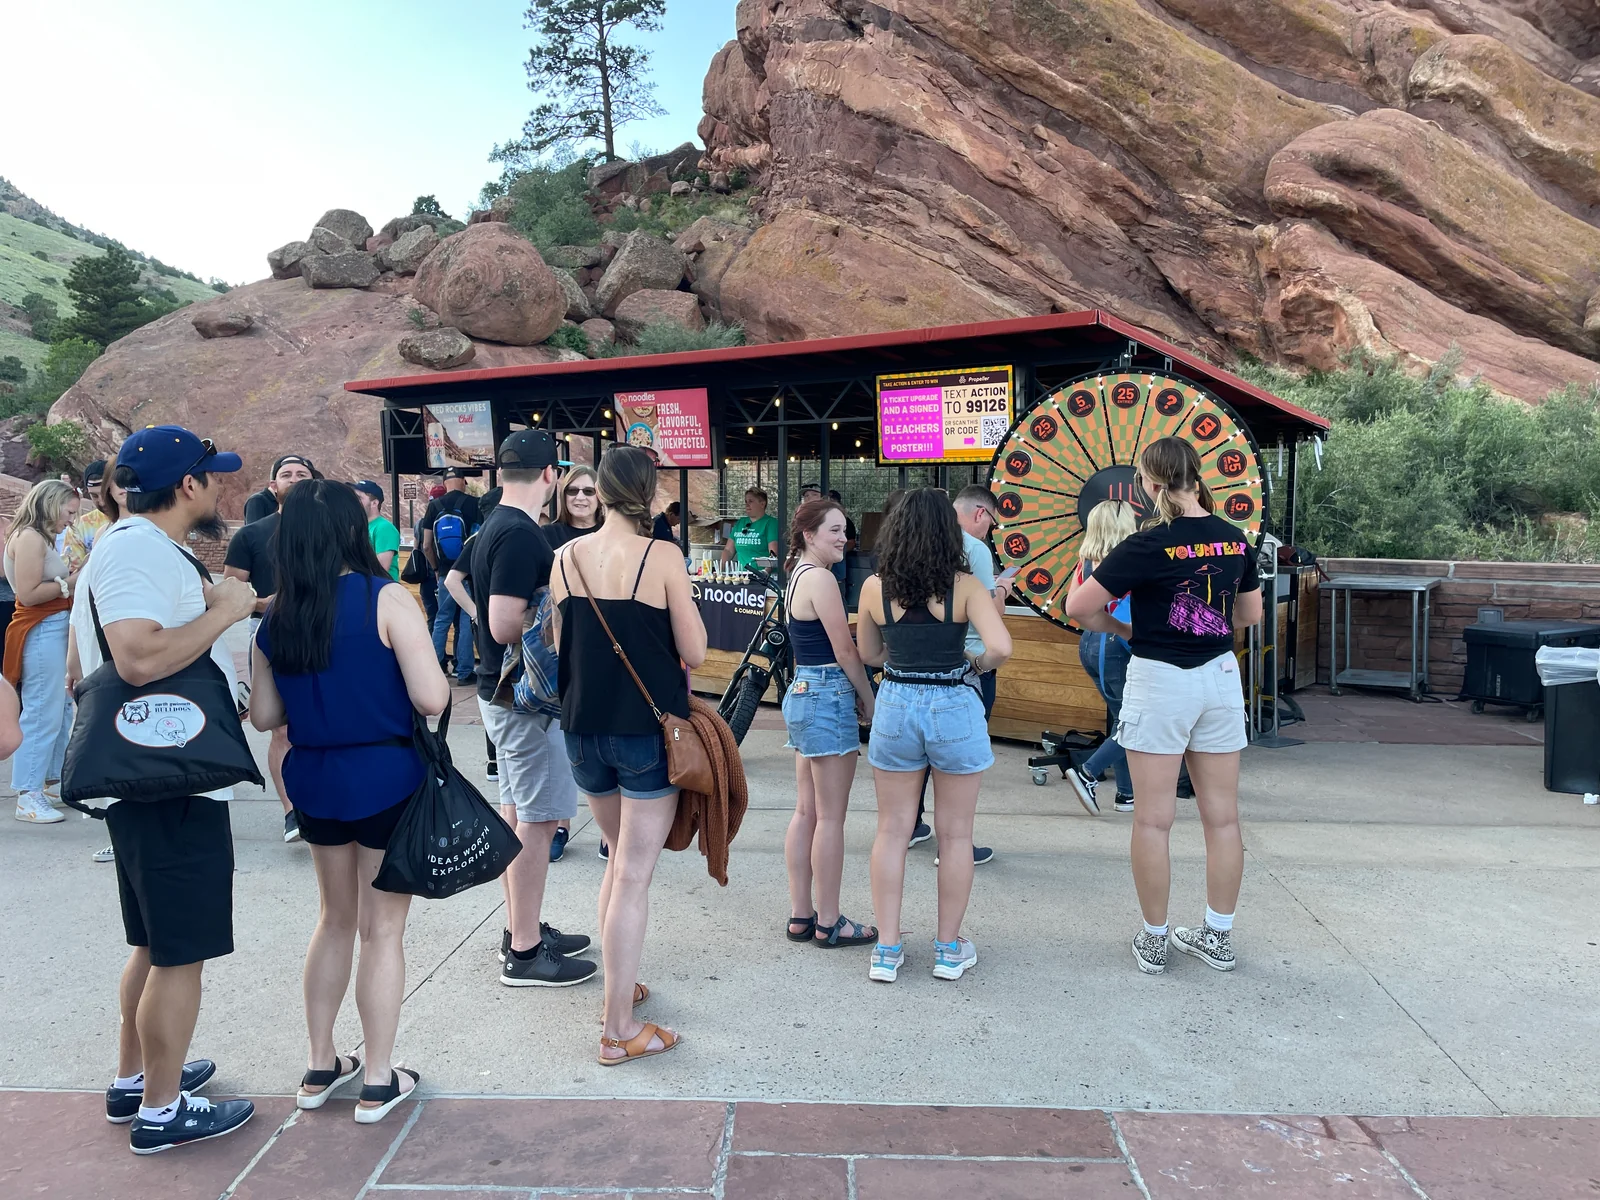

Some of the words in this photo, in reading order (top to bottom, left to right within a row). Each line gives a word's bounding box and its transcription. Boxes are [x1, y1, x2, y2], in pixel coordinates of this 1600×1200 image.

[628, 392, 656, 402] noodles
[944, 388, 968, 399] TEXT
[971, 386, 1006, 398] ACTION
[1117, 388, 1134, 400] 25
[888, 396, 910, 404] TICKET
[910, 394, 938, 402] UPGRADE
[1076, 396, 1086, 408] 5
[432, 406, 444, 414] RED
[445, 404, 466, 414] ROCKS
[468, 403, 486, 412] VIBES
[657, 402, 682, 415] FRESH,
[884, 406, 900, 415] AND
[902, 406, 908, 414] A
[910, 404, 940, 414] SIGNED
[944, 400, 961, 414] TO
[966, 398, 1006, 413] 99126
[658, 415, 702, 428] FLAVORFUL,
[1034, 419, 1050, 436] 25
[884, 423, 940, 434] BLEACHERS
[945, 427, 956, 436] QR
[958, 426, 978, 434] CODE
[891, 442, 934, 452] POSTER!!!
[1010, 458, 1022, 468] 5
[1227, 454, 1242, 472] 25
[1236, 502, 1248, 512] 5
[1008, 538, 1024, 555] 25
[1164, 541, 1247, 560] VOLUNTEER
[704, 587, 764, 608] noodles
[738, 608, 764, 616] COMPANY
[428, 853, 459, 865] IDEAS
[462, 825, 490, 857] WORTH
[432, 842, 490, 876] EXPLORING
